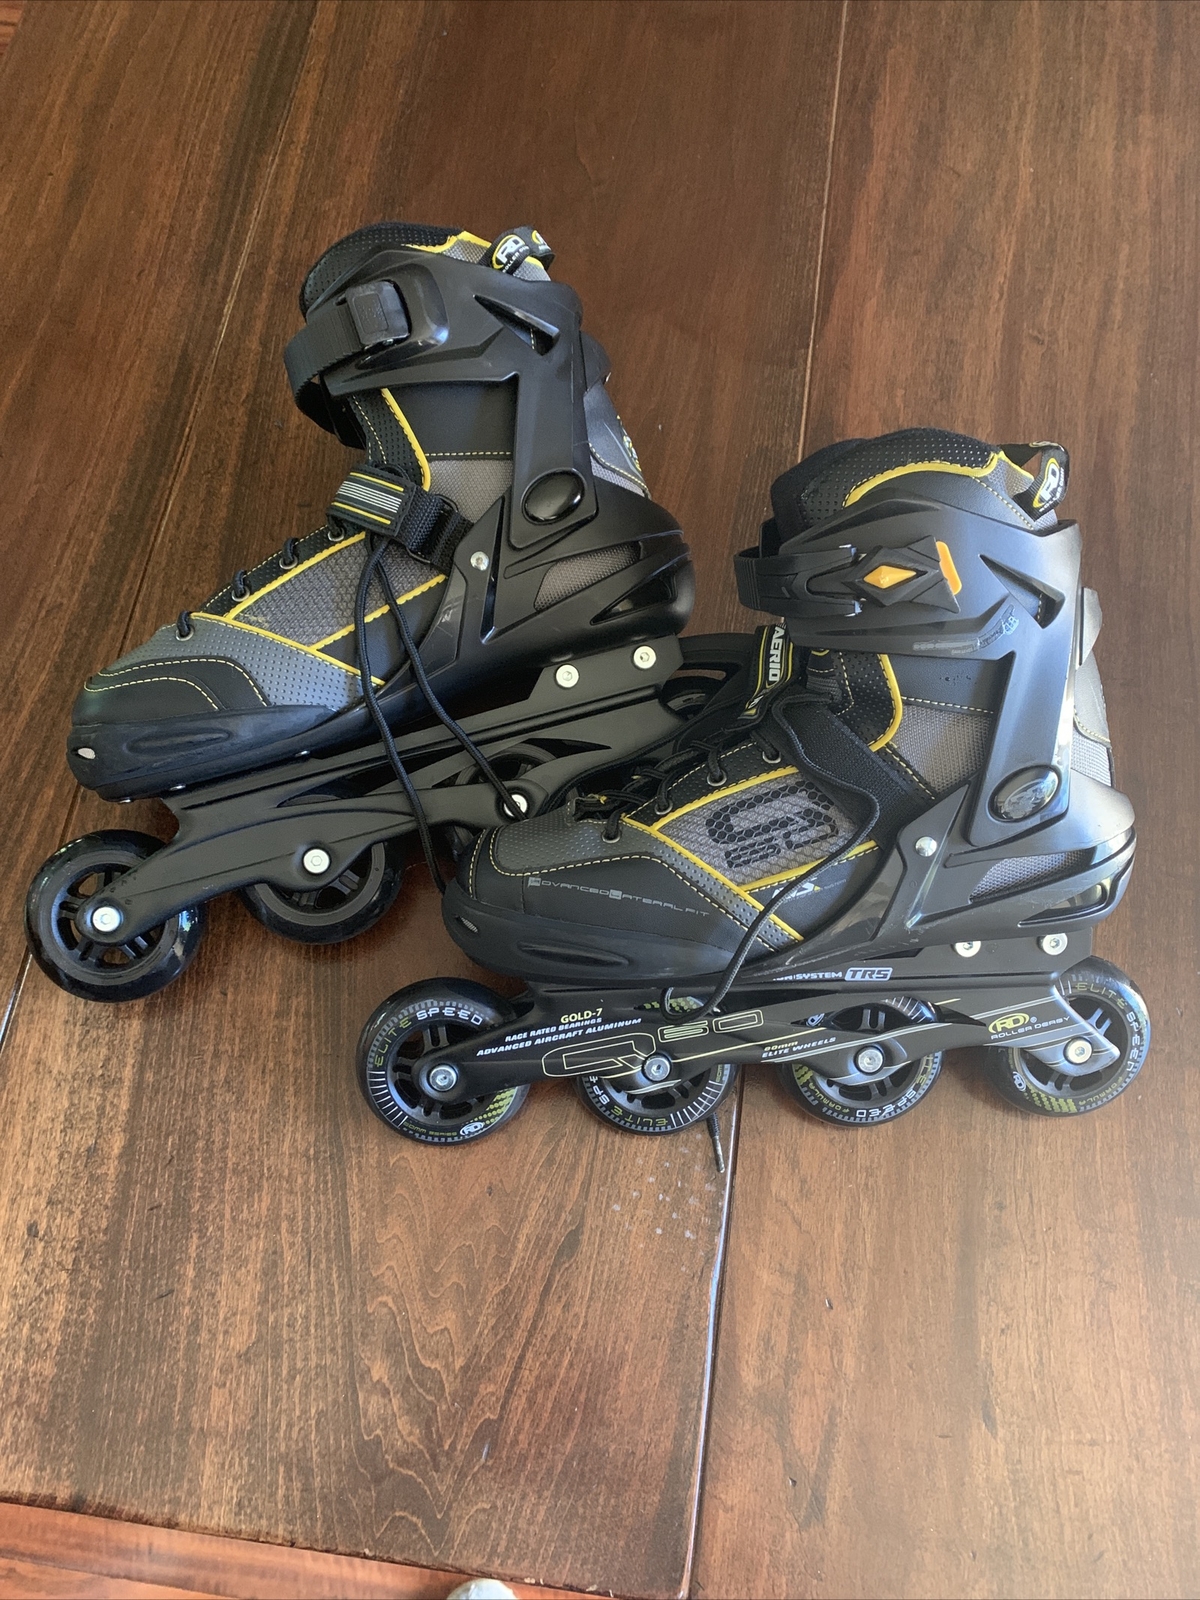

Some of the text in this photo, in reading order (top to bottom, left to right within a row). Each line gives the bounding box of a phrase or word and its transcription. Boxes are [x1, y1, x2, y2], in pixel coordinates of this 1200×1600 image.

[768, 626, 785, 682] AERIO
[795, 971, 843, 980] SYSTEM
[848, 969, 890, 980] TRS
[1075, 981, 1128, 1009] ELITE
[415, 1006, 483, 1026] SPEED
[560, 1008, 603, 1024] GOLD-7
[990, 1016, 1070, 1041] ROLLER DERBY
[374, 1016, 412, 1067] ELITE
[476, 1018, 642, 1057] ADVANCED AIRCRAFT ALUMINUM
[504, 1017, 602, 1043] RACE RATED BEARINGS
[761, 1036, 837, 1058] ELITE WHEELS
[807, 1081, 850, 1113] FORMULA
[855, 1087, 917, 1117] SPEED
[1078, 1075, 1123, 1106] FORMULA
[610, 1105, 669, 1126] ELITE
